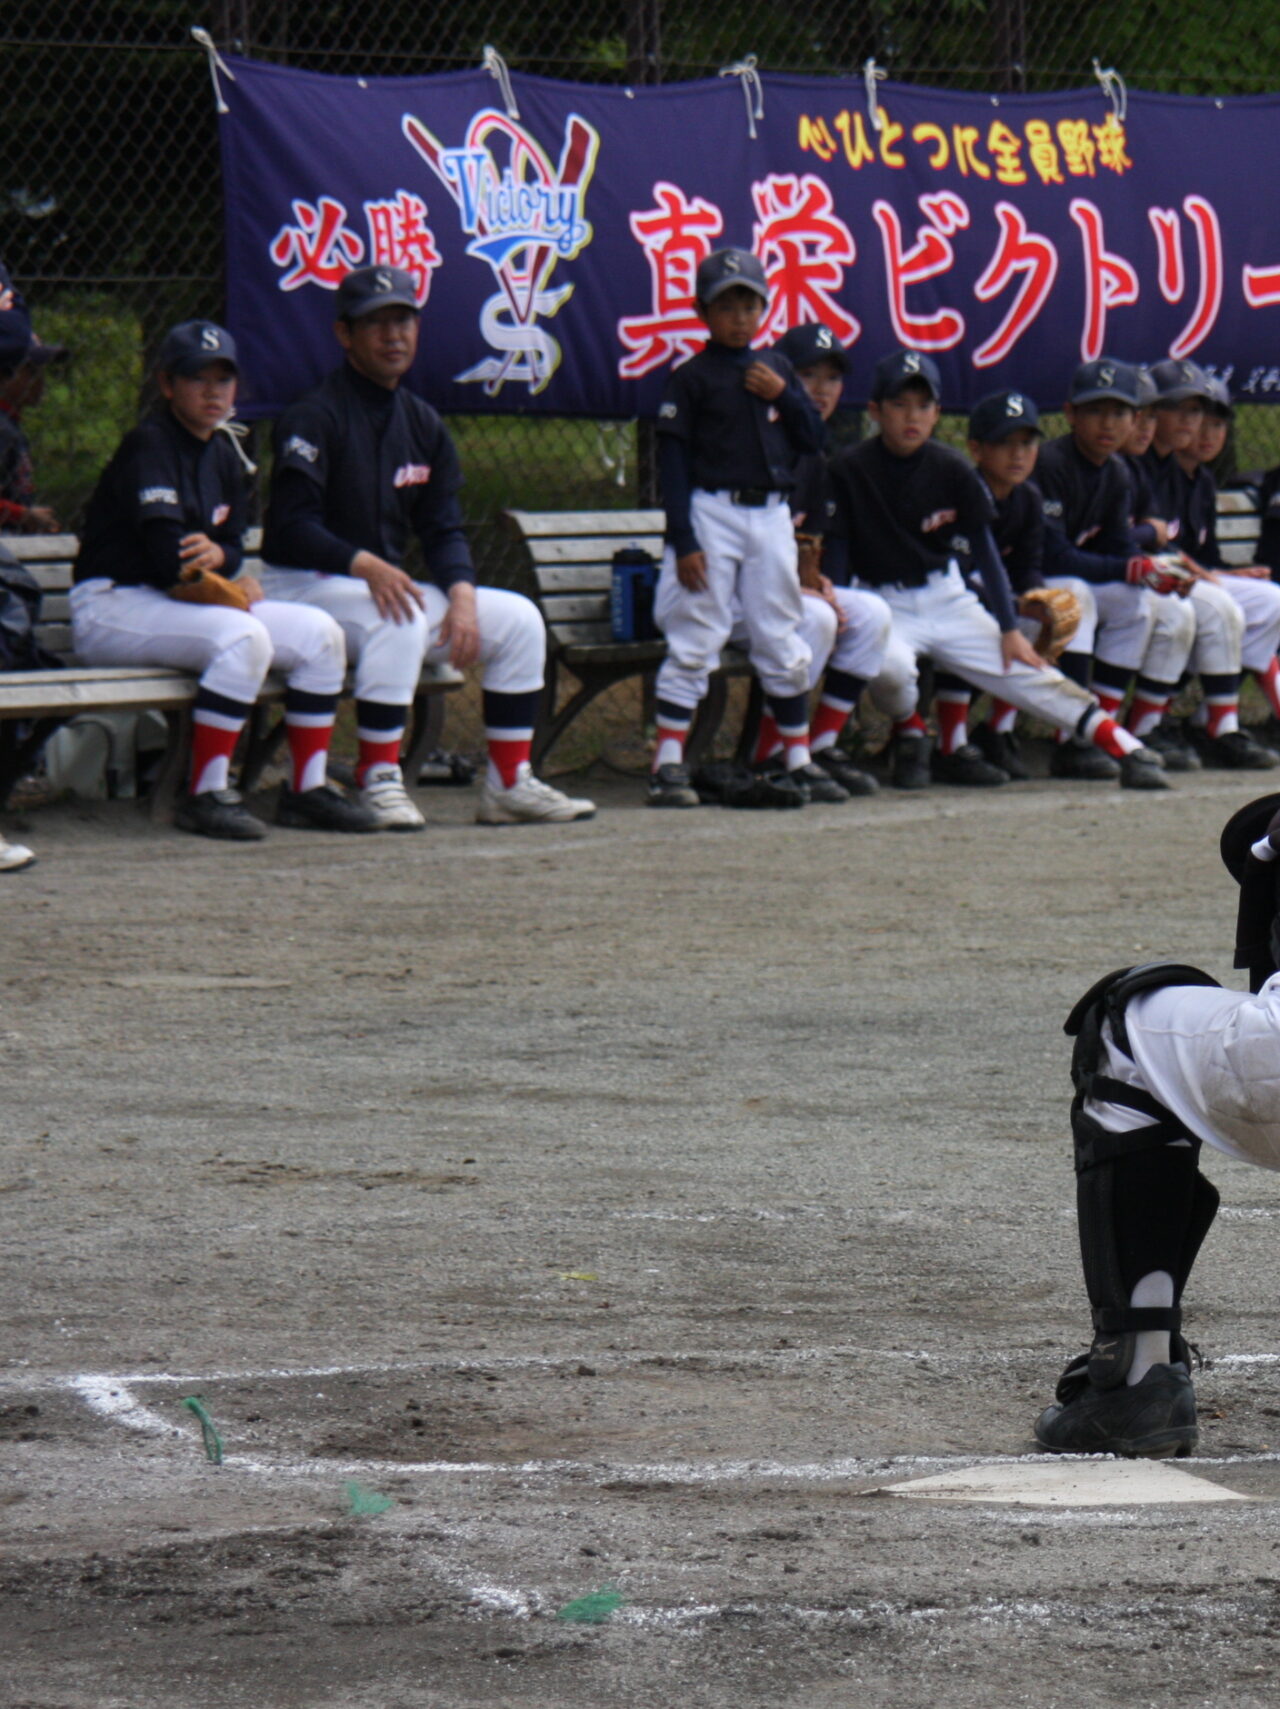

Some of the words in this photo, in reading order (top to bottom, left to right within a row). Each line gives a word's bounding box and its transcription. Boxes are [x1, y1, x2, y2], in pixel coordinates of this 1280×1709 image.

[797, 107, 1133, 184] 心ひとつに全員野球
[440, 150, 590, 255] Victory
[724, 252, 741, 275] S
[374, 271, 393, 293] S
[201, 328, 221, 351] S
[816, 325, 834, 349] S
[903, 352, 921, 374] S
[1098, 366, 1117, 388] S
[1006, 392, 1024, 417] S
